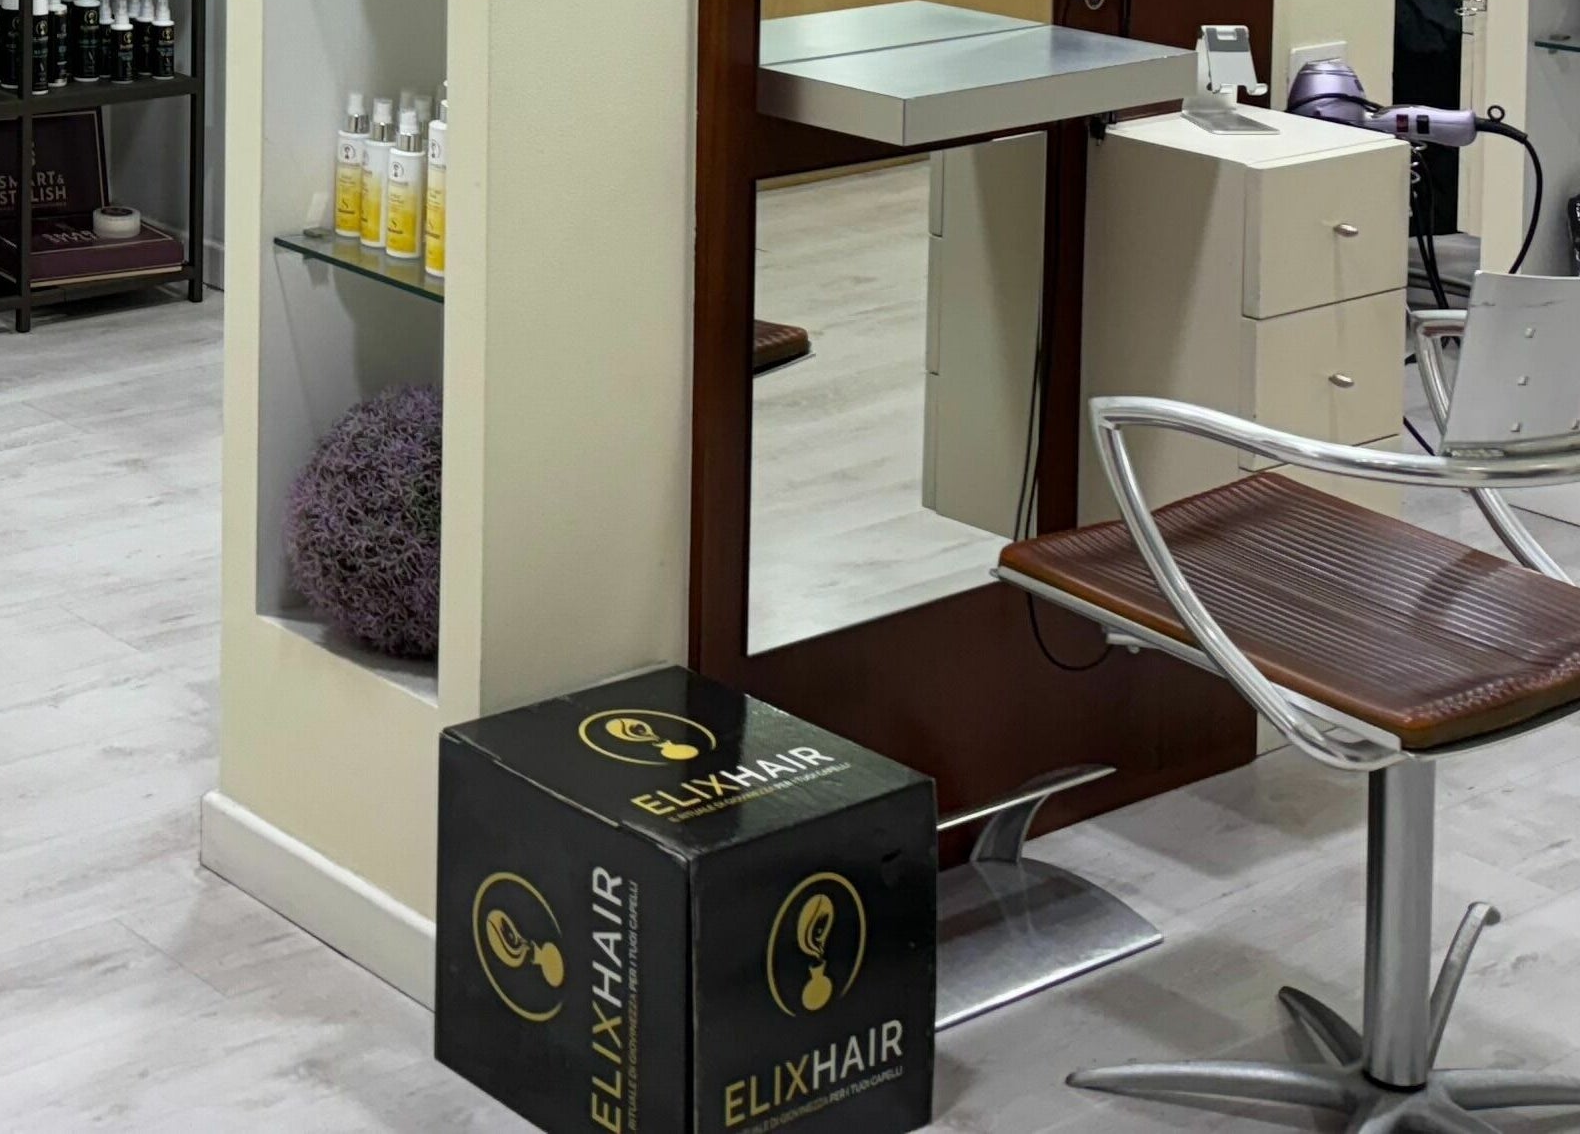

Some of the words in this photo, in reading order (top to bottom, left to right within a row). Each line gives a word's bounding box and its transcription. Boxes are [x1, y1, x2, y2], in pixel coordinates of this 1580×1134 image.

[0, 185, 67, 205] STLISH
[630, 746, 835, 816] ELIXHAIR
[628, 879, 639, 931] CAPELLI
[591, 866, 623, 1134] ELIXHAIR
[627, 967, 639, 994] PER
[725, 1018, 904, 1128] ELIXHAIR
